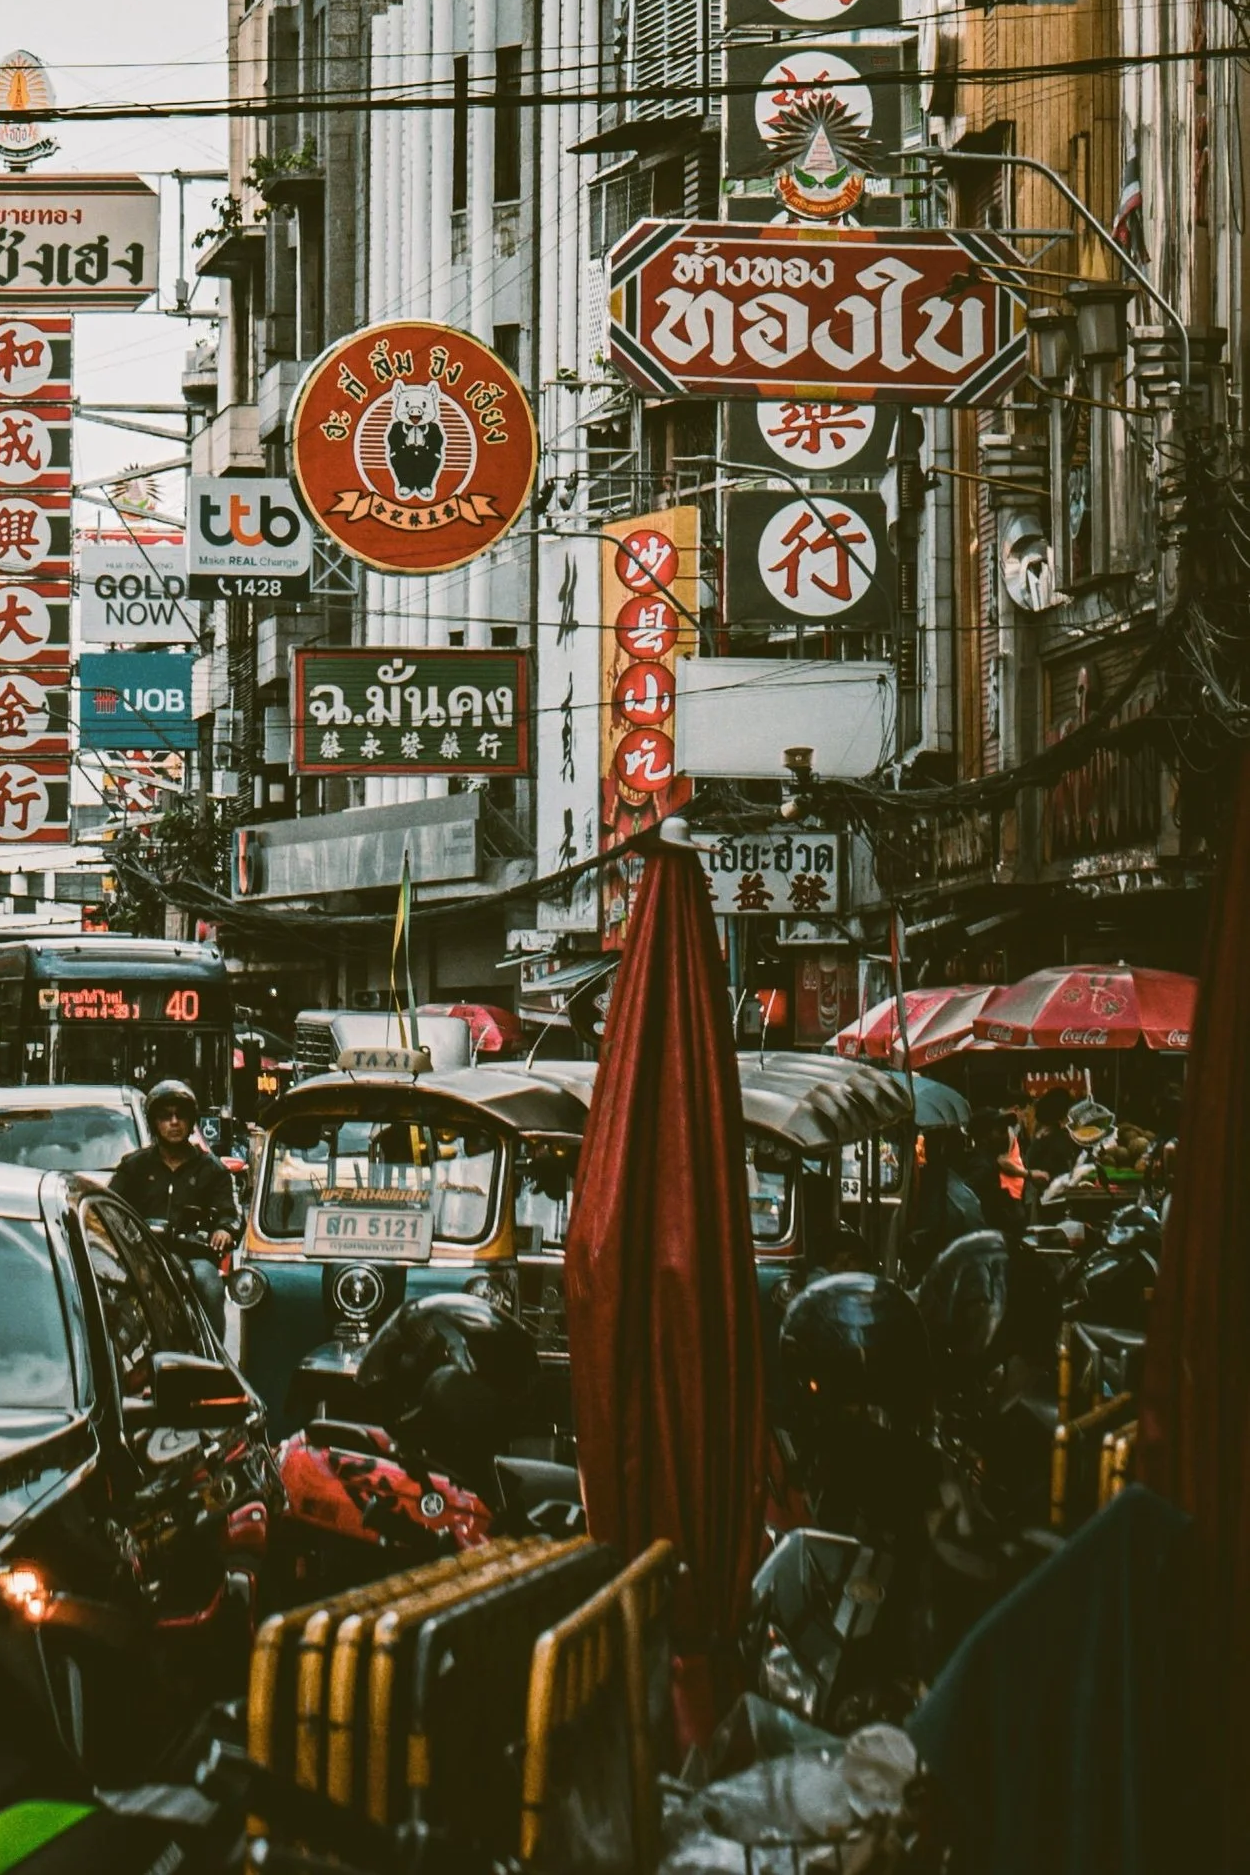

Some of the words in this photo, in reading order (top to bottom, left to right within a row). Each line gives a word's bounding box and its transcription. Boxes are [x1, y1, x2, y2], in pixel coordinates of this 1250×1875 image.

[672, 242, 835, 289] ห้างทอง
[650, 258, 984, 373] ทองใบ
[199, 494, 300, 547] ttb
[199, 555, 225, 566] Make
[228, 555, 256, 566] REAL
[259, 556, 299, 568] Change
[95, 574, 184, 600] GOLD
[234, 578, 282, 597] 1428
[106, 602, 175, 625] NOW
[623, 536, 671, 785] 沙县小吃
[124, 688, 185, 713] UOB
[309, 658, 513, 727] ฉ.มั่นคง
[705, 875, 832, 912] 益發
[165, 991, 199, 1021] 40
[353, 1050, 411, 1069] TAXI
[326, 1214, 358, 1237] สก
[368, 1216, 418, 1239] 5121
